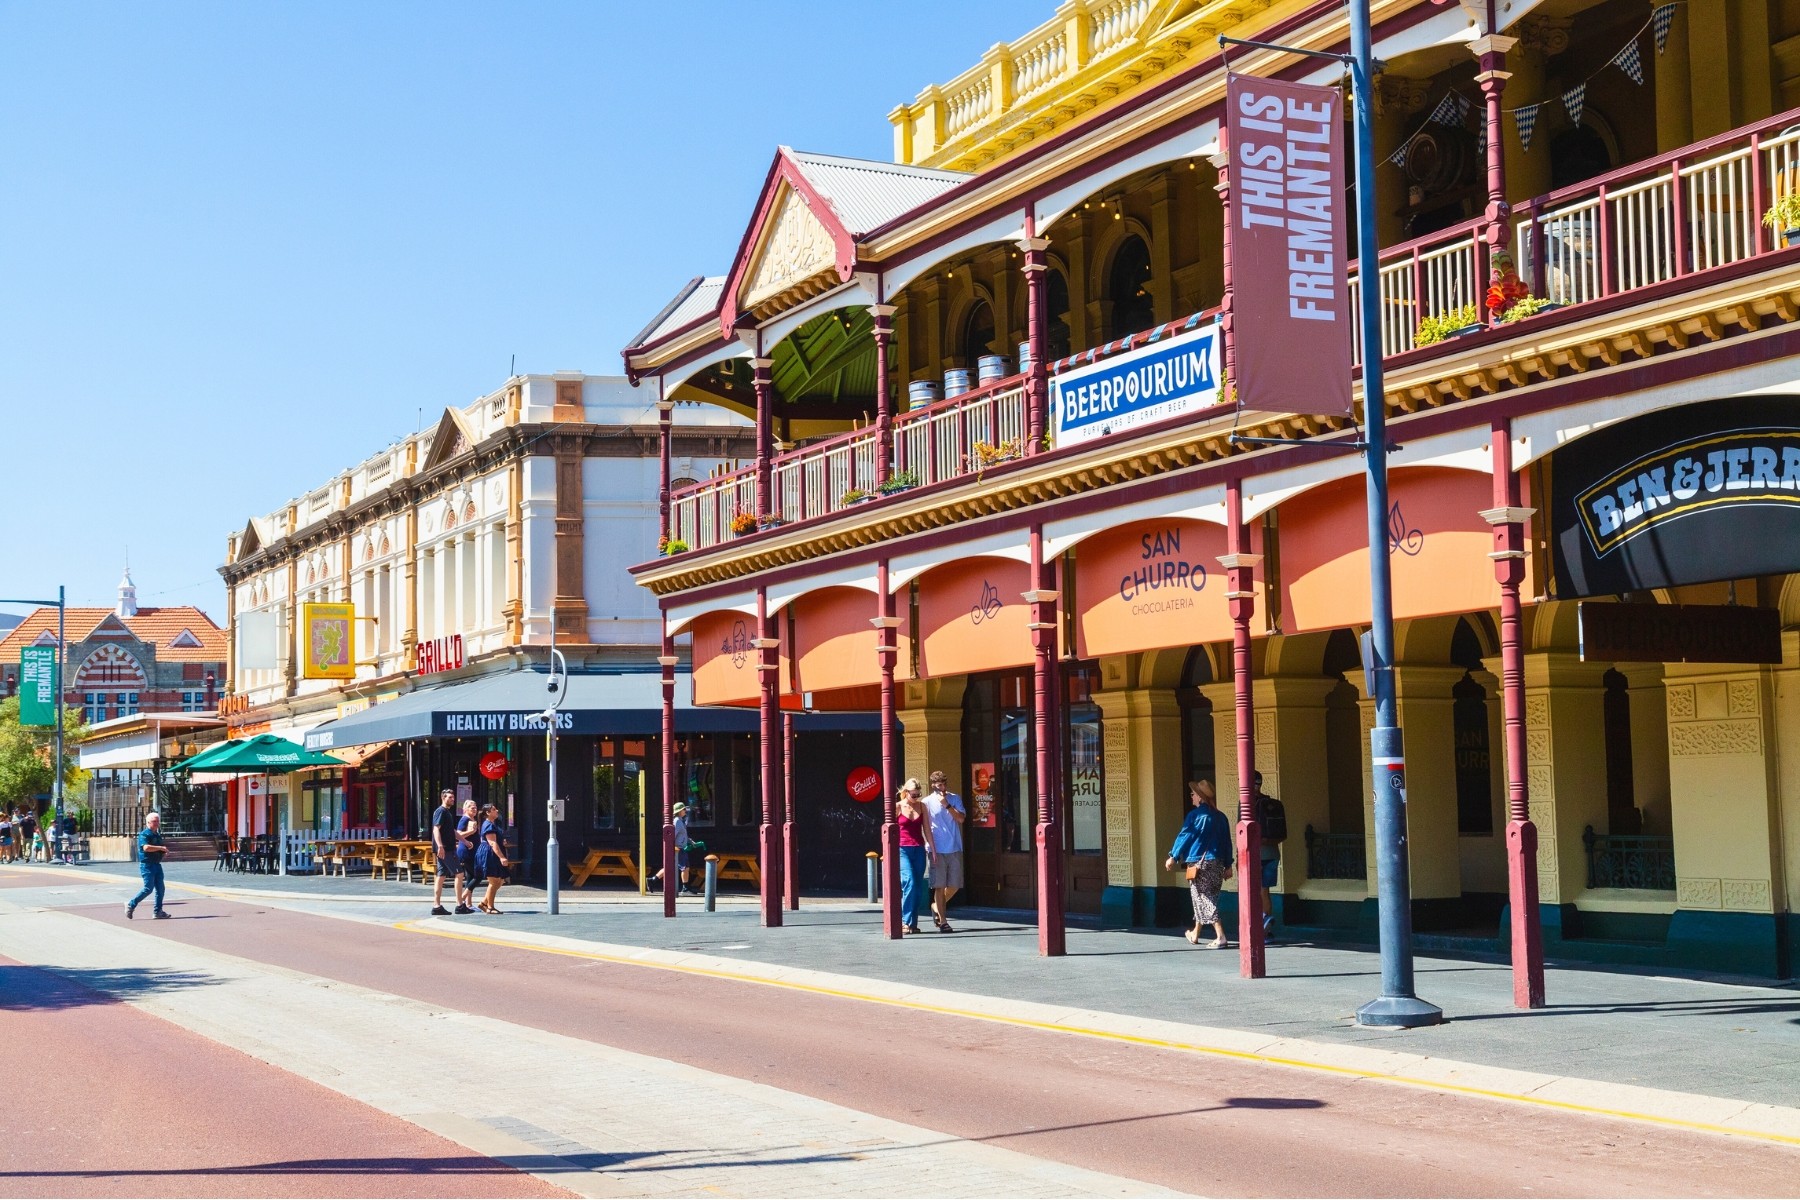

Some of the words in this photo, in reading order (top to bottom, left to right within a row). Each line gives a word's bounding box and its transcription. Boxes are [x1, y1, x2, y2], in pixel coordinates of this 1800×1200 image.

[1239, 92, 1284, 133] IS
[1240, 143, 1284, 229] THIS
[1286, 98, 1335, 321] FREMANTLE
[1065, 348, 1208, 422] BEERPOURIUM
[1128, 414, 1135, 424] OF
[1140, 407, 1163, 420] CRAFT
[1168, 400, 1187, 412] BEER
[1141, 528, 1180, 559] SAN
[1120, 561, 1206, 602] CHURRO
[1132, 598, 1194, 616] CHOCOLATERIA
[23, 650, 38, 660] IS
[23, 661, 38, 683] THIS
[418, 634, 463, 676] GRILL'D
[37, 650, 52, 703] FREMANTLE
[446, 714, 506, 731] HEALTHY
[509, 712, 573, 730] BURGRS
[851, 773, 877, 795] Grill'd
